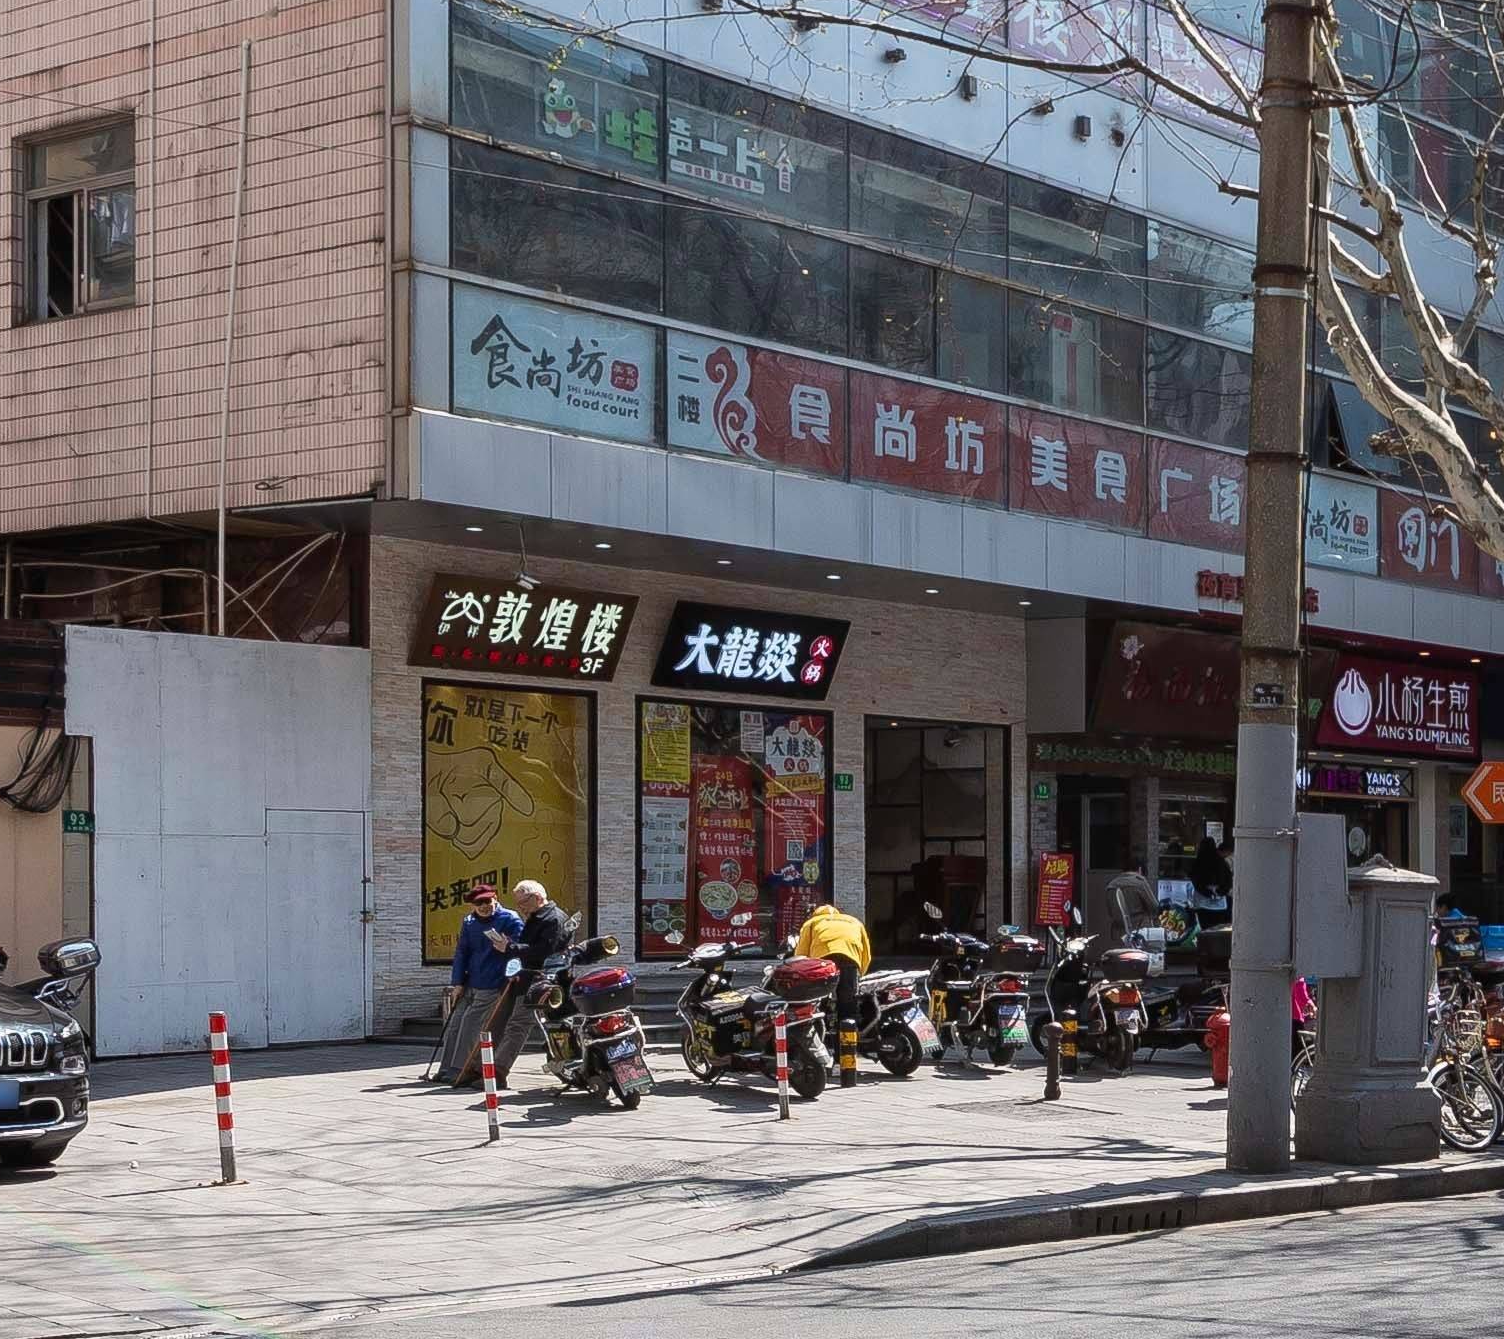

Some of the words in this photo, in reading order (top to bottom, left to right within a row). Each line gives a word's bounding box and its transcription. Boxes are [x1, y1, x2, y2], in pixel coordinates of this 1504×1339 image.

[470, 313, 607, 398] 食尚坊
[566, 394, 599, 411] food
[602, 403, 639, 419] court
[488, 590, 624, 656] 敦煌楼
[579, 657, 604, 674] 3F
[465, 694, 560, 734] 就是下一个
[1375, 672, 1470, 730] 小杨生煎
[488, 725, 529, 753] 吃货
[1375, 724, 1414, 741] YANG'S
[1415, 728, 1470, 746] DUMPLING
[1366, 771, 1401, 786] YANG'S
[70, 813, 86, 825] 93
